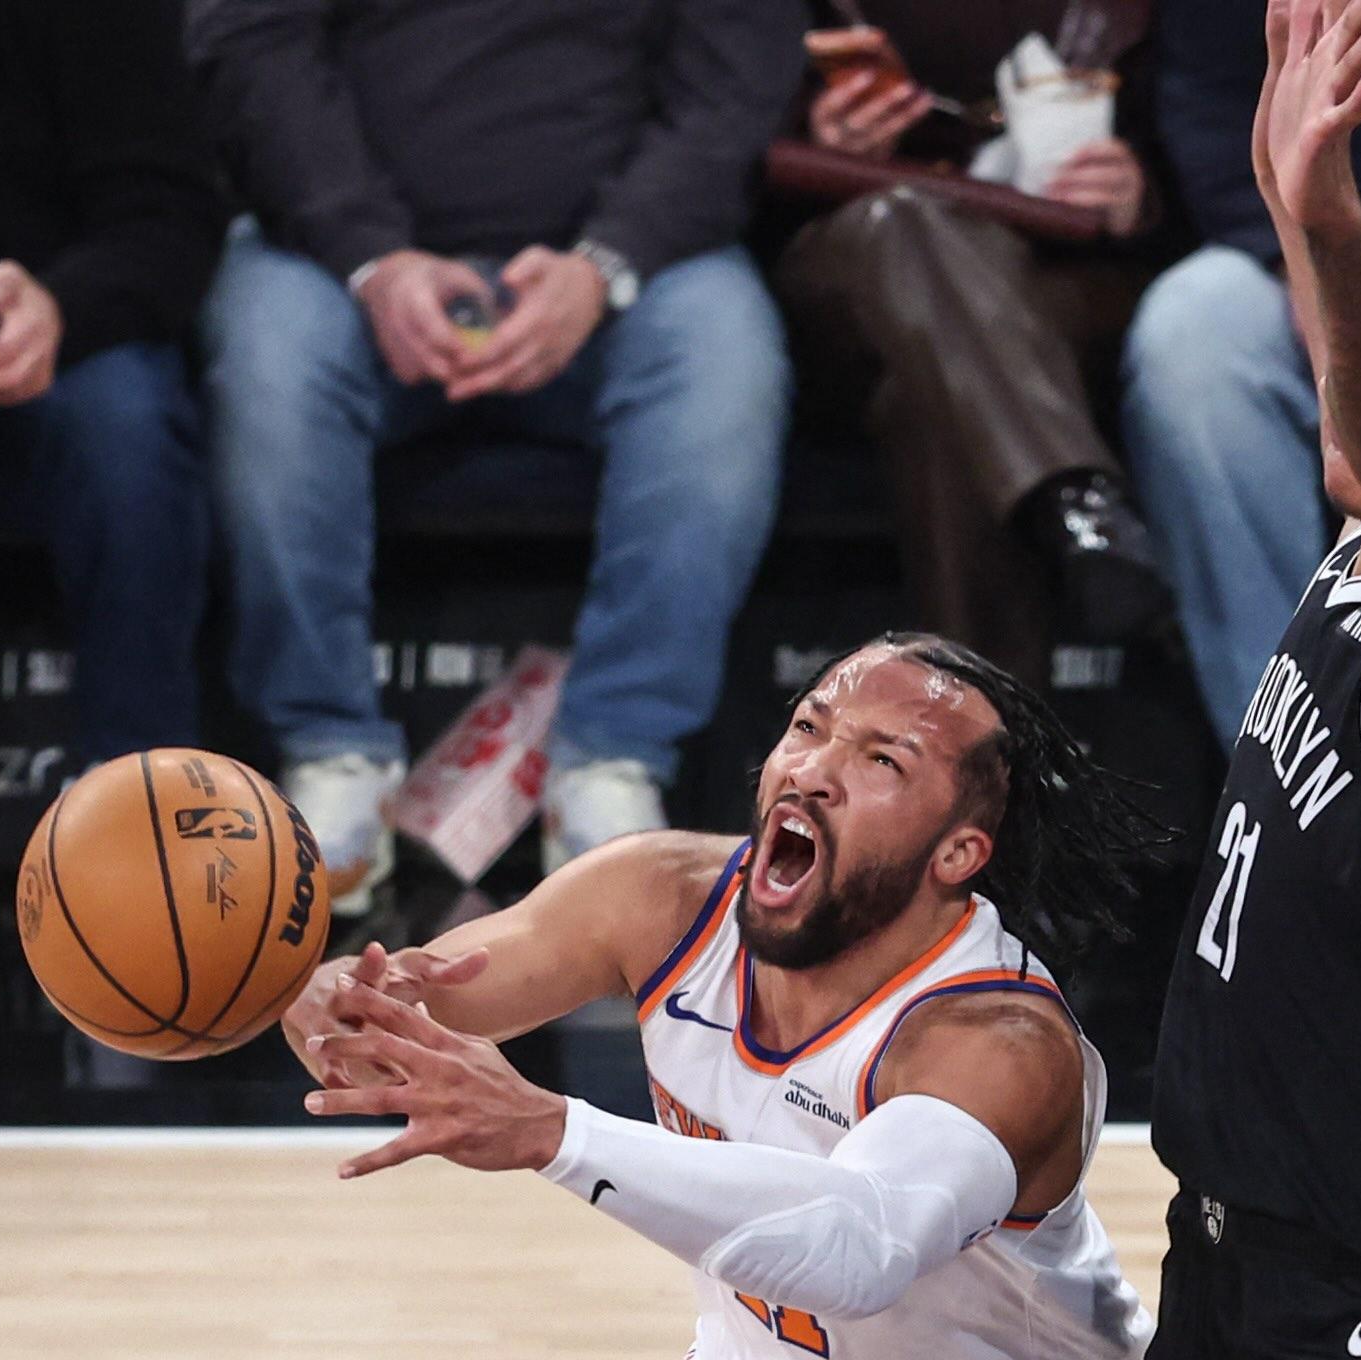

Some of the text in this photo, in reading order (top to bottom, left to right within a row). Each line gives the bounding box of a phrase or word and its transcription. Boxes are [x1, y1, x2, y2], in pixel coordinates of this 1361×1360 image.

[1235, 653, 1354, 832] ROOKLYN
[1195, 801, 1262, 983] 21
[785, 1089, 850, 1131] abu dhabi
